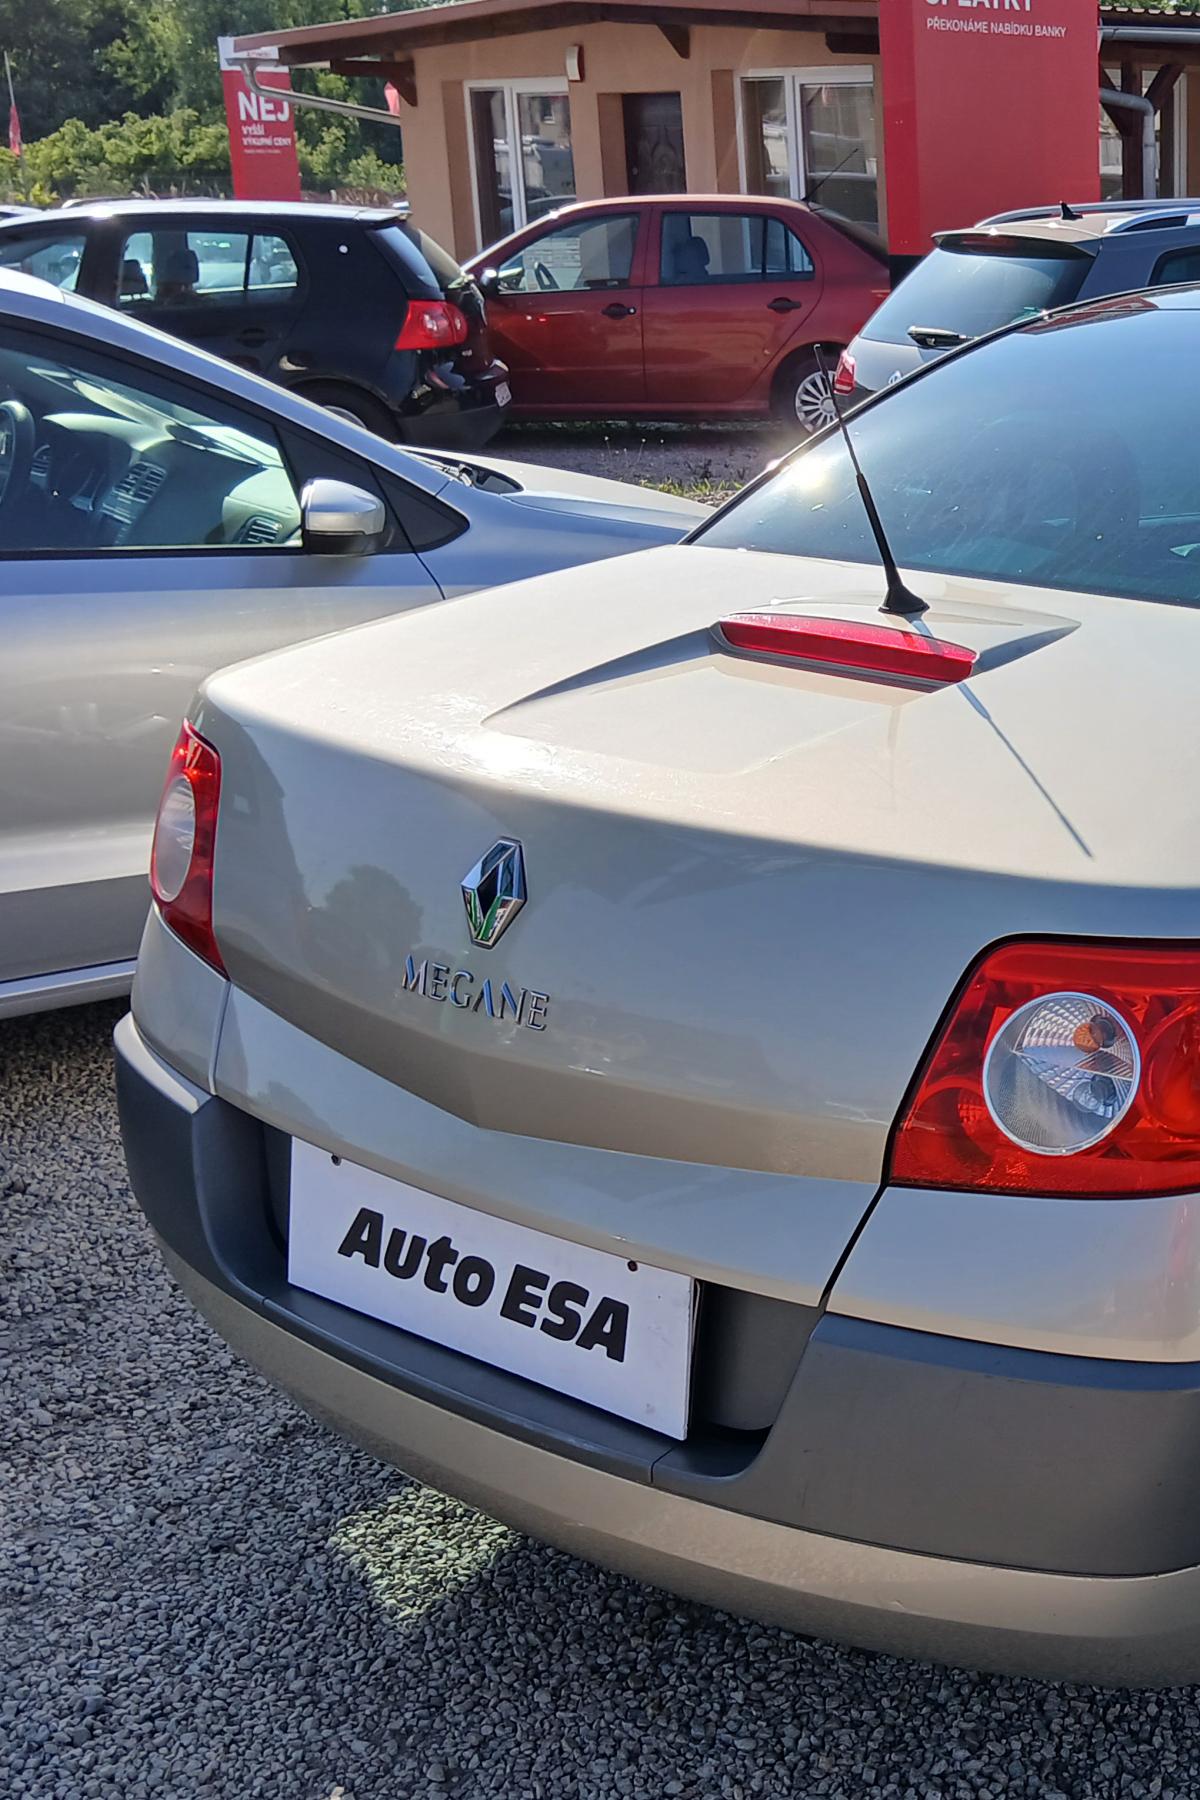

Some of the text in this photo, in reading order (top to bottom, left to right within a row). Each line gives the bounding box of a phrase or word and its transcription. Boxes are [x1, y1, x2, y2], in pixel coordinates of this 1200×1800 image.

[926, 16, 1066, 38] PŘEKONÁME NABÍDKU BANKY
[238, 91, 289, 121] NEJ
[402, 954, 551, 1031] MEGANE
[338, 1207, 629, 1363] Auto ESA
